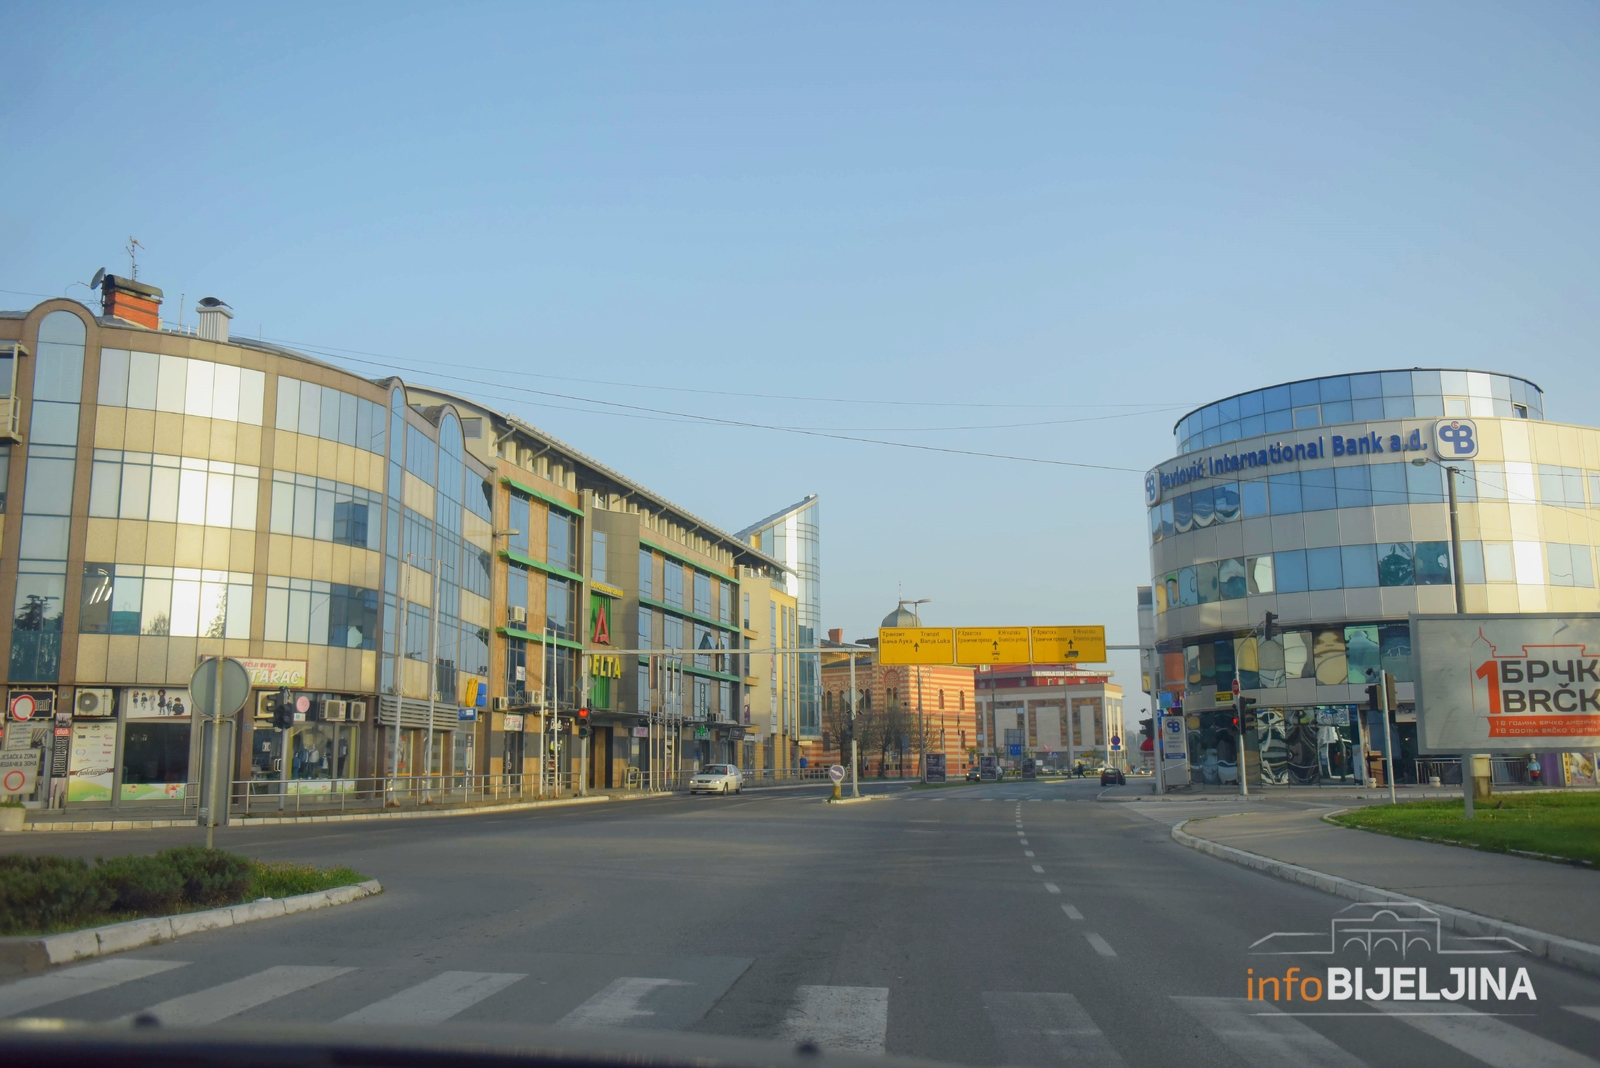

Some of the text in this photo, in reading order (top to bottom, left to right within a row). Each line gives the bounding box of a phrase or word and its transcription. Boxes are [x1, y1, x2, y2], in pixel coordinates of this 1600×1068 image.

[1160, 428, 1428, 491] Pavlović International Bank a.d.
[247, 669, 300, 685] TARAC
[1501, 659, 1600, 683] БРЧК
[1475, 660, 1501, 714] 1
[1502, 683, 1600, 713] BRČK
